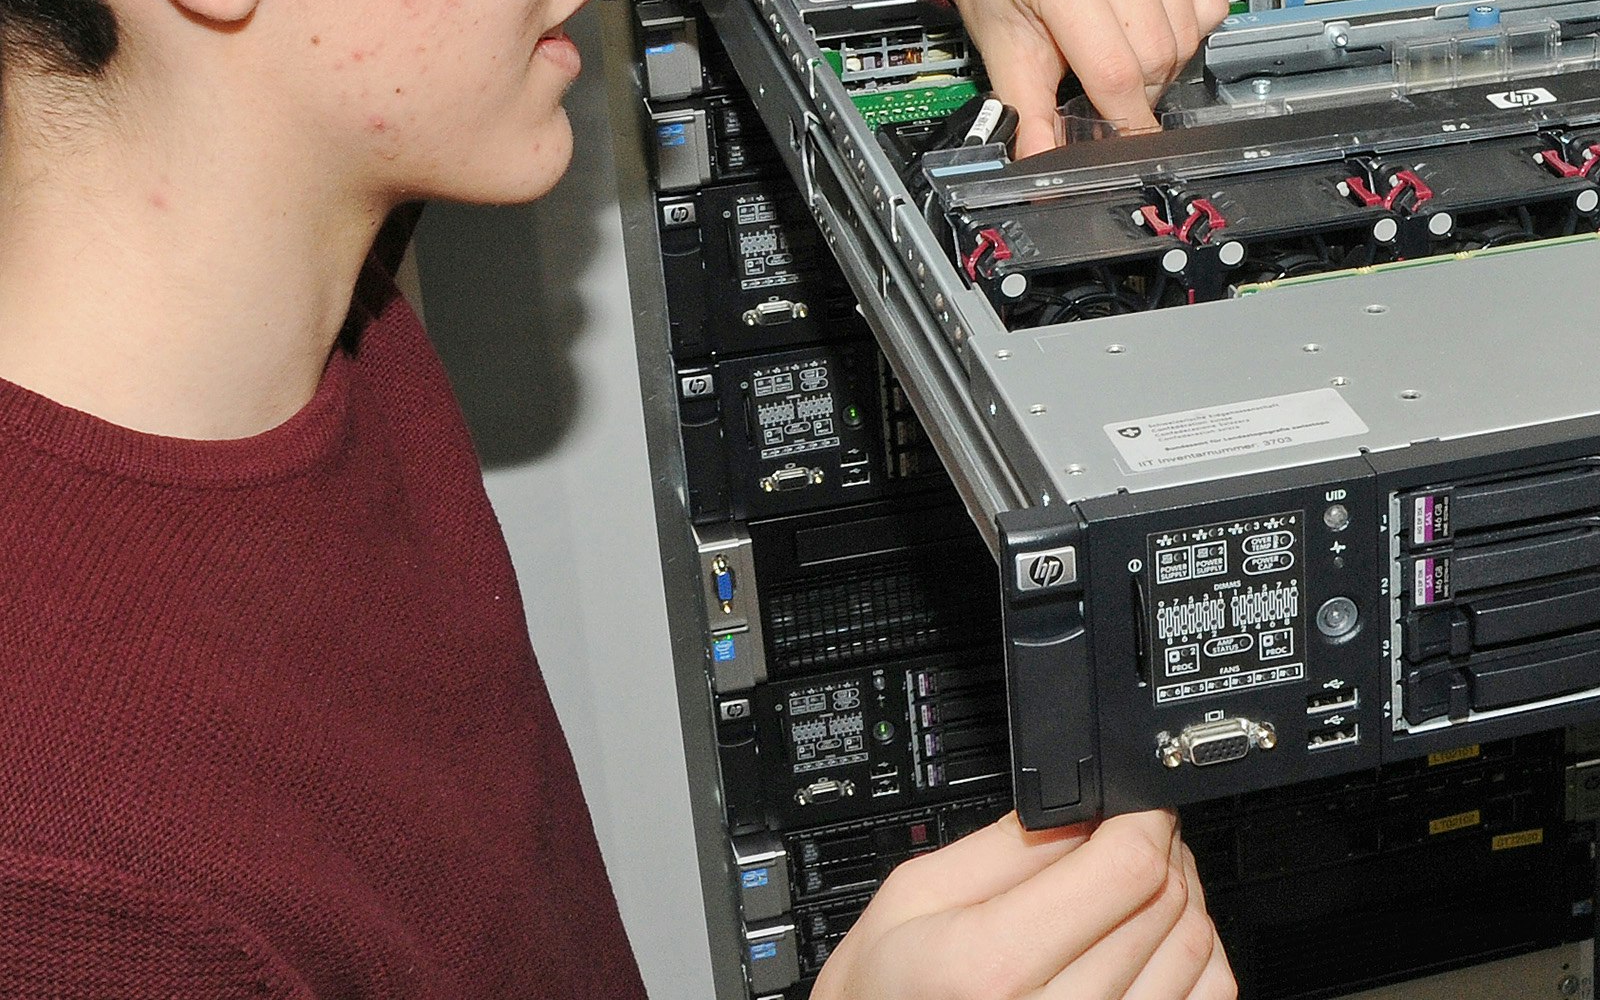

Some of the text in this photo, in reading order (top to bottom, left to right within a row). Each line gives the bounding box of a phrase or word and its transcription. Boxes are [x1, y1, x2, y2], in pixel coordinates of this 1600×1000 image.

[670, 206, 688, 223] hp
[688, 376, 707, 395] hp
[1262, 436, 1293, 446] 3703
[1325, 489, 1346, 501] UID
[1289, 516, 1295, 524] 4
[1381, 514, 1388, 524] 1
[1434, 503, 1442, 532] 146 GB
[1254, 522, 1259, 530] 3
[1183, 533, 1187, 541] 1
[1218, 528, 1224, 536] 2
[1251, 537, 1272, 546] OVER
[1218, 546, 1224, 554] 2
[1196, 558, 1223, 568] POWER
[1252, 556, 1279, 566] POWER
[1258, 562, 1273, 570] CAP
[1029, 555, 1064, 587] hp
[1160, 563, 1187, 573] POWER
[1196, 565, 1223, 574] SUPPLY
[1435, 566, 1443, 579] GB
[1161, 571, 1187, 580] SUPPLY
[1214, 580, 1241, 591] DIMMS
[1381, 578, 1389, 588] 2
[1212, 644, 1239, 654] STATUS
[1382, 640, 1390, 650] 3
[1190, 647, 1196, 655] 2
[1266, 646, 1288, 656] PROC
[1172, 662, 1194, 672] PROC
[1220, 665, 1241, 675] FANS
[1174, 688, 1180, 696] 6
[1199, 683, 1205, 691] 5
[1223, 679, 1229, 687] 4
[1247, 675, 1252, 683] 3
[1271, 671, 1277, 679] 2
[1384, 702, 1390, 711] 4
